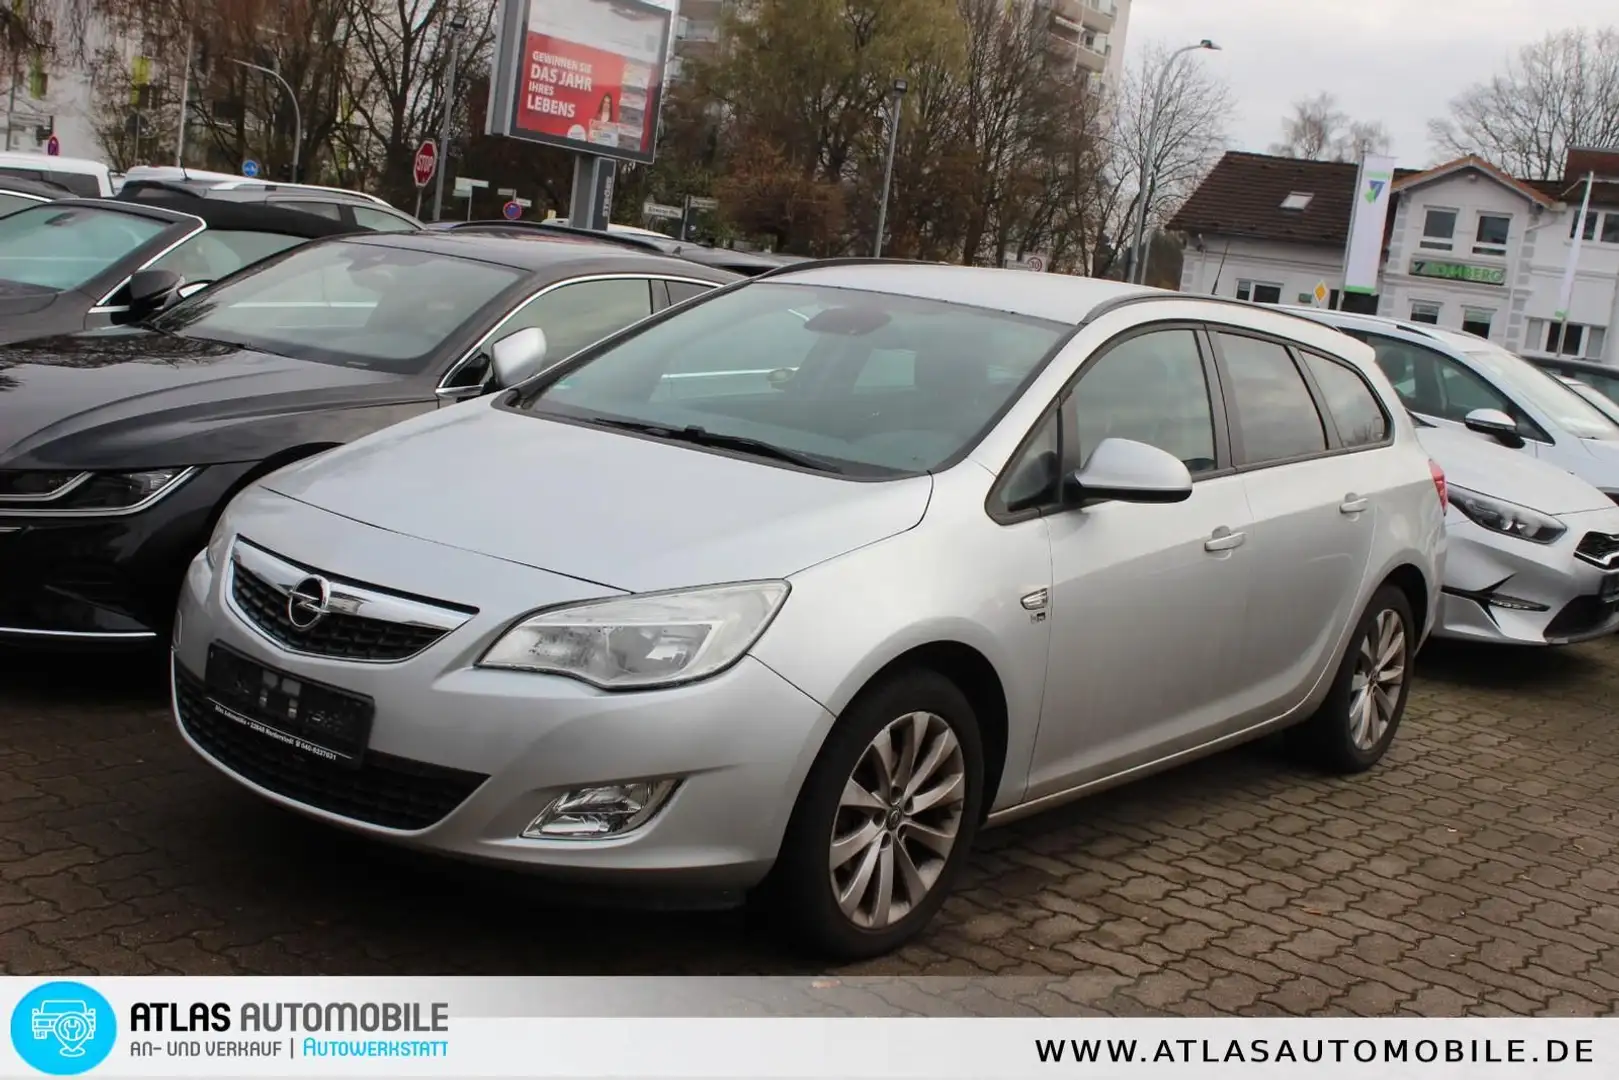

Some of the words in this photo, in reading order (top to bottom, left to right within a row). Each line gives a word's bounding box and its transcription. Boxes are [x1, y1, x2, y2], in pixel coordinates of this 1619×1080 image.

[532, 50, 577, 71] GEWINNEN
[579, 61, 592, 73] SIE
[528, 81, 554, 96] IHRES
[530, 64, 559, 83] DAS
[560, 72, 592, 92] JAHR
[527, 94, 575, 118] LEBENS
[416, 154, 433, 172] STOP
